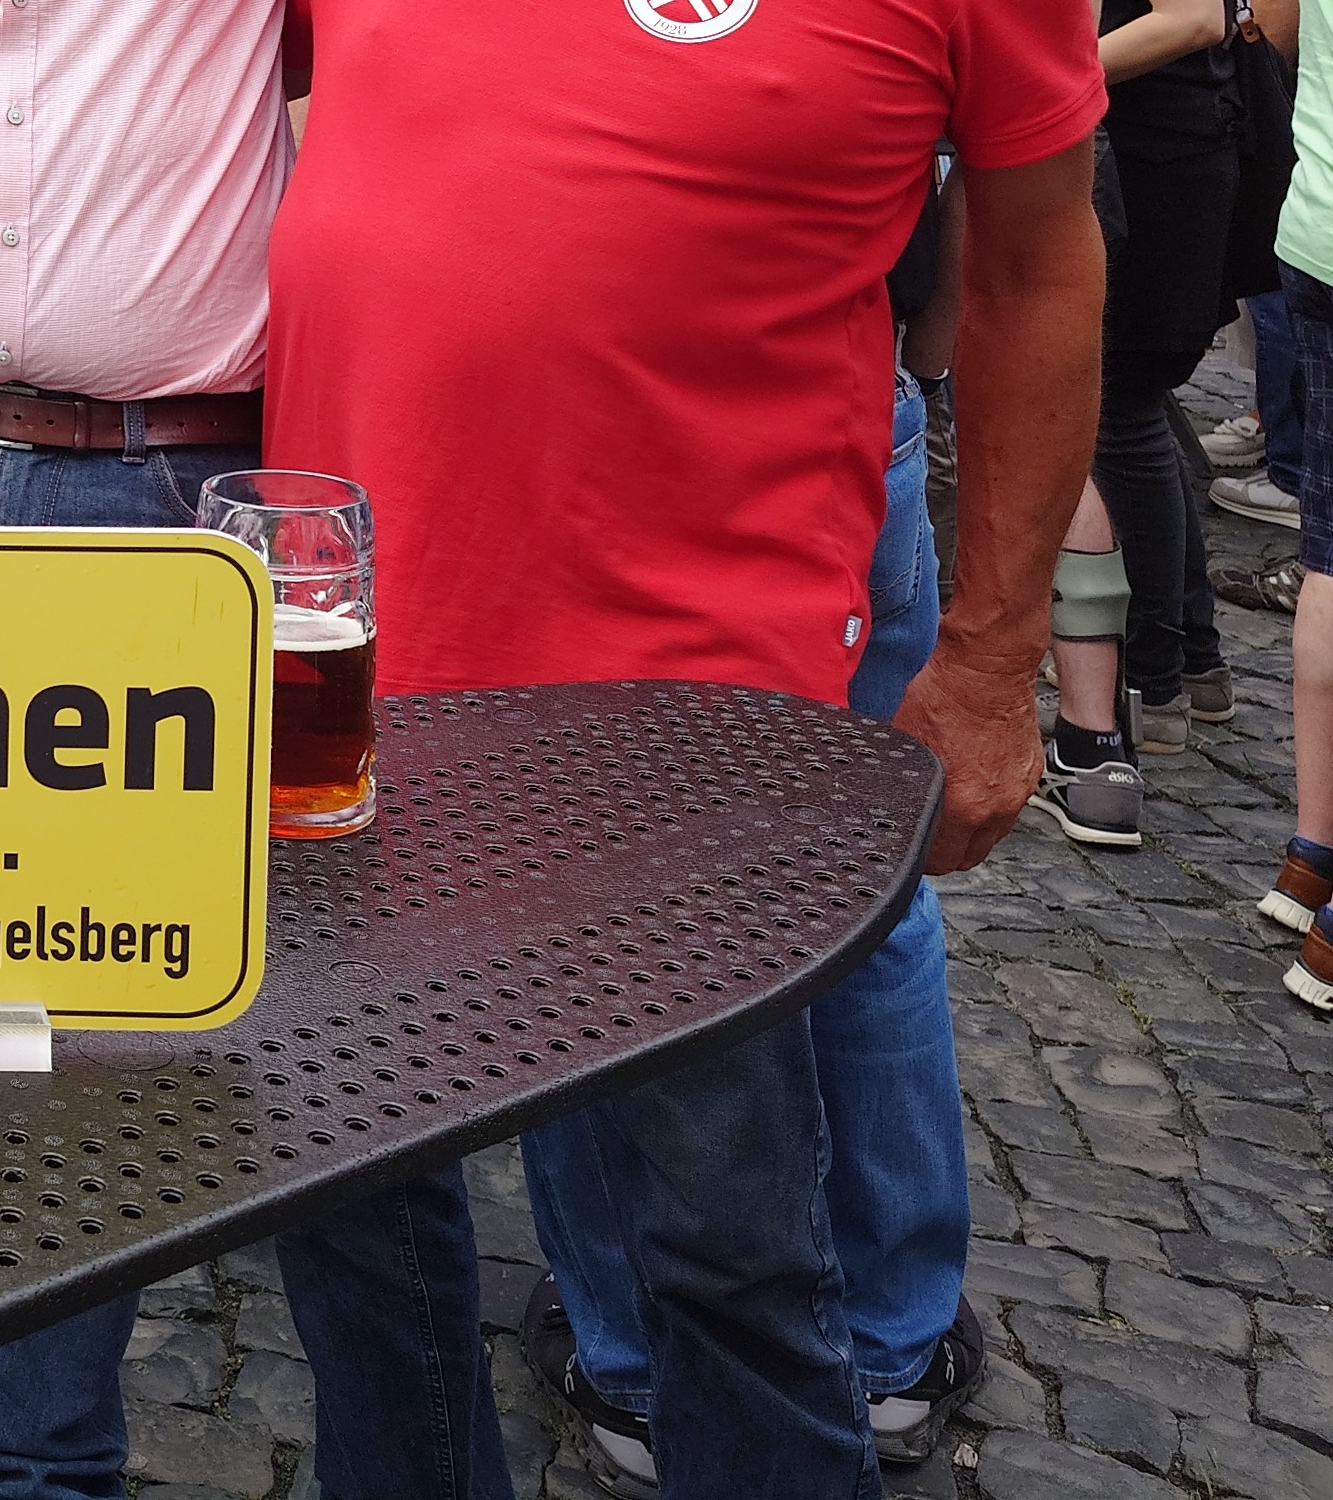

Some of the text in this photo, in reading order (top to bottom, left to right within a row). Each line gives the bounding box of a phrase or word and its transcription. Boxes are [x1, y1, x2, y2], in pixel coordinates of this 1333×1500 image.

[653, 18, 687, 36] 1928
[844, 619, 856, 644] JAKO
[1108, 770, 1134, 785] asics
